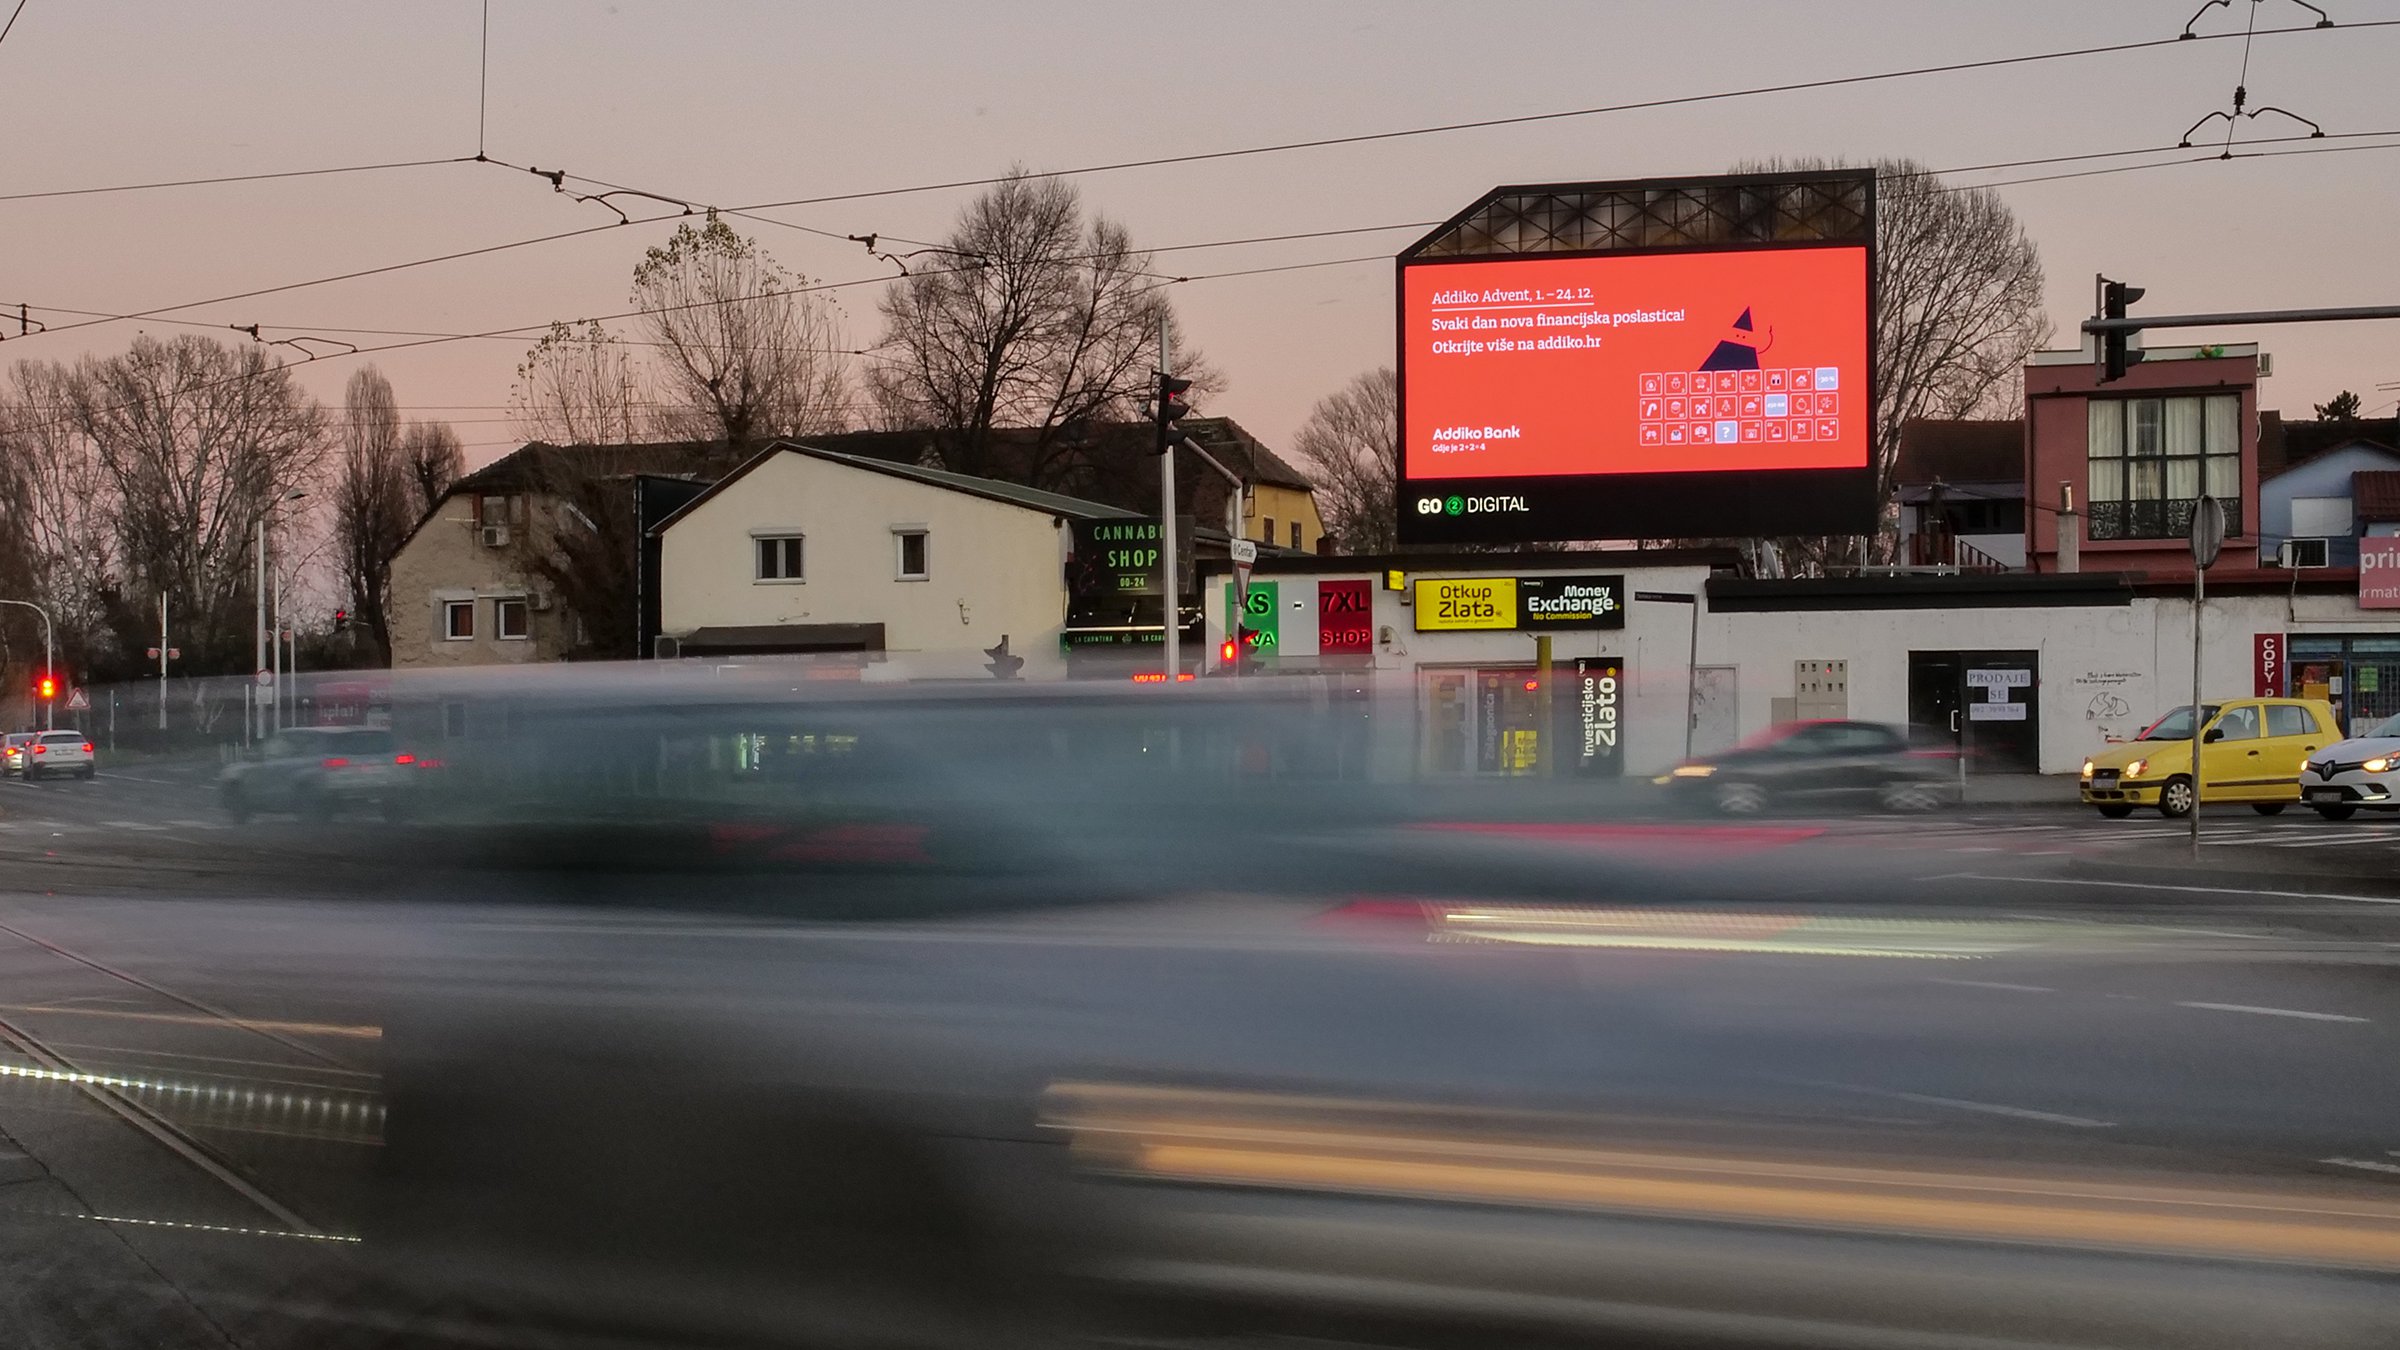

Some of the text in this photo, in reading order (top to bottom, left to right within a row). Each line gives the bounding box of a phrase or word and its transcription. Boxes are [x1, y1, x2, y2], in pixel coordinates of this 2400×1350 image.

[1432, 291, 1478, 304] Addiko
[1482, 289, 1532, 303] Advent,
[1536, 290, 1544, 300] 1.
[1557, 289, 1575, 300] 24.
[1577, 288, 1593, 298] 12.
[1432, 309, 1685, 331] Svaki dan nova financijska poslastica!
[1432, 335, 1601, 356] Otkrijte više na addiko.hr
[1432, 425, 1520, 440] Addiko Bank
[1432, 444, 1450, 453] Gdje
[1451, 445, 1458, 453] je
[1417, 498, 1442, 514] GO
[1467, 496, 1530, 513] DIGITAL
[1094, 525, 1163, 541] CANNABI
[1108, 550, 1158, 568] SHOP
[2360, 547, 2400, 574] pri
[1120, 578, 1145, 587] 00-24
[1440, 585, 1492, 601] Otkup
[1565, 585, 1610, 599] Money
[2371, 587, 2400, 598] mat
[1320, 592, 1369, 613] 7XL
[1438, 601, 1494, 618] Zlata
[1546, 612, 1593, 620] Commission
[1322, 631, 1370, 645] SHOP
[2263, 638, 2276, 683] COPY
[1969, 673, 2028, 683] PRODAJE
[1990, 690, 2005, 699] SE
[1582, 677, 1595, 757] Investicijsko
[1596, 677, 1616, 747] Zlato
